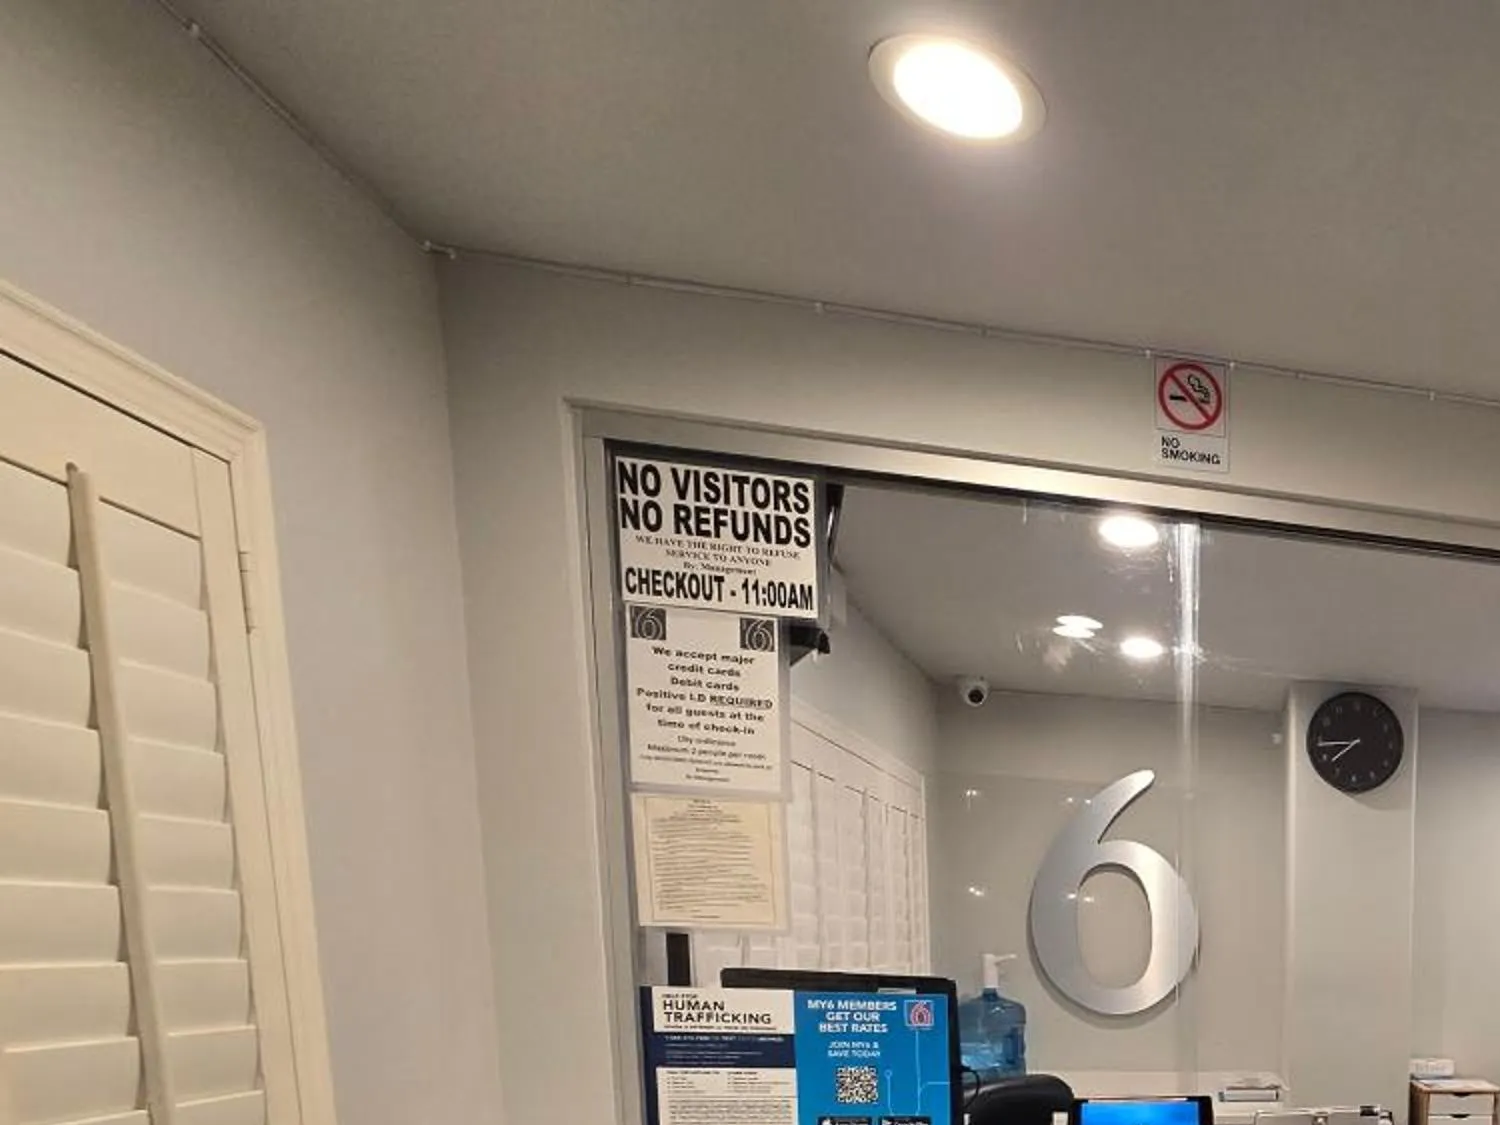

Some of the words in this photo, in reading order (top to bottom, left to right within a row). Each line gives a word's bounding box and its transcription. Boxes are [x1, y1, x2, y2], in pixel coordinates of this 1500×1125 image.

[1161, 436, 1180, 448] NO
[1162, 448, 1221, 464] SMOKING
[618, 461, 661, 497] NO
[671, 467, 810, 515] VISITORS
[620, 498, 662, 532] NO
[673, 504, 811, 548] REFUNDS
[635, 534, 652, 545] WE
[654, 536, 685, 548] HAVE
[687, 540, 708, 551] THE
[710, 542, 743, 554] RIGHT
[746, 546, 759, 555] TO
[761, 547, 800, 560] REFUSE
[665, 549, 710, 561] SERVICE
[713, 553, 727, 563] TO
[730, 555, 771, 567] ANYONE
[700, 563, 757, 576] Management
[625, 567, 725, 602] CHECKOUT
[742, 578, 814, 611] 11:00AM
[652, 646, 671, 657] We
[675, 650, 717, 662] accept
[721, 655, 755, 665] major
[668, 663, 703, 673] credit
[707, 668, 741, 677] cards
[670, 677, 703, 687] Debit
[705, 681, 740, 692] cards
[636, 687, 686, 700] Positive
[709, 694, 773, 709] REQUIRED
[646, 703, 663, 712] for
[667, 705, 682, 714] all
[685, 708, 726, 719] guests
[729, 711, 742, 720] at
[745, 712, 765, 722] the
[657, 719, 685, 728] time
[688, 721, 701, 730] of
[703, 722, 755, 735] check-in
[1030, 769, 1199, 1015] 6
[663, 1000, 724, 1011] HUMAN
[808, 999, 834, 1010] MY6
[837, 1000, 897, 1011] MEMBERS
[664, 1011, 771, 1024] TRAFFICKING
[825, 1011, 850, 1021] GET
[853, 1012, 880, 1021] OUR
[819, 1023, 850, 1033] BEST
[851, 1023, 888, 1033] RATES
[828, 1041, 849, 1049] JOIN
[827, 1049, 849, 1057] SAVE
[851, 1049, 881, 1057] TODAY
